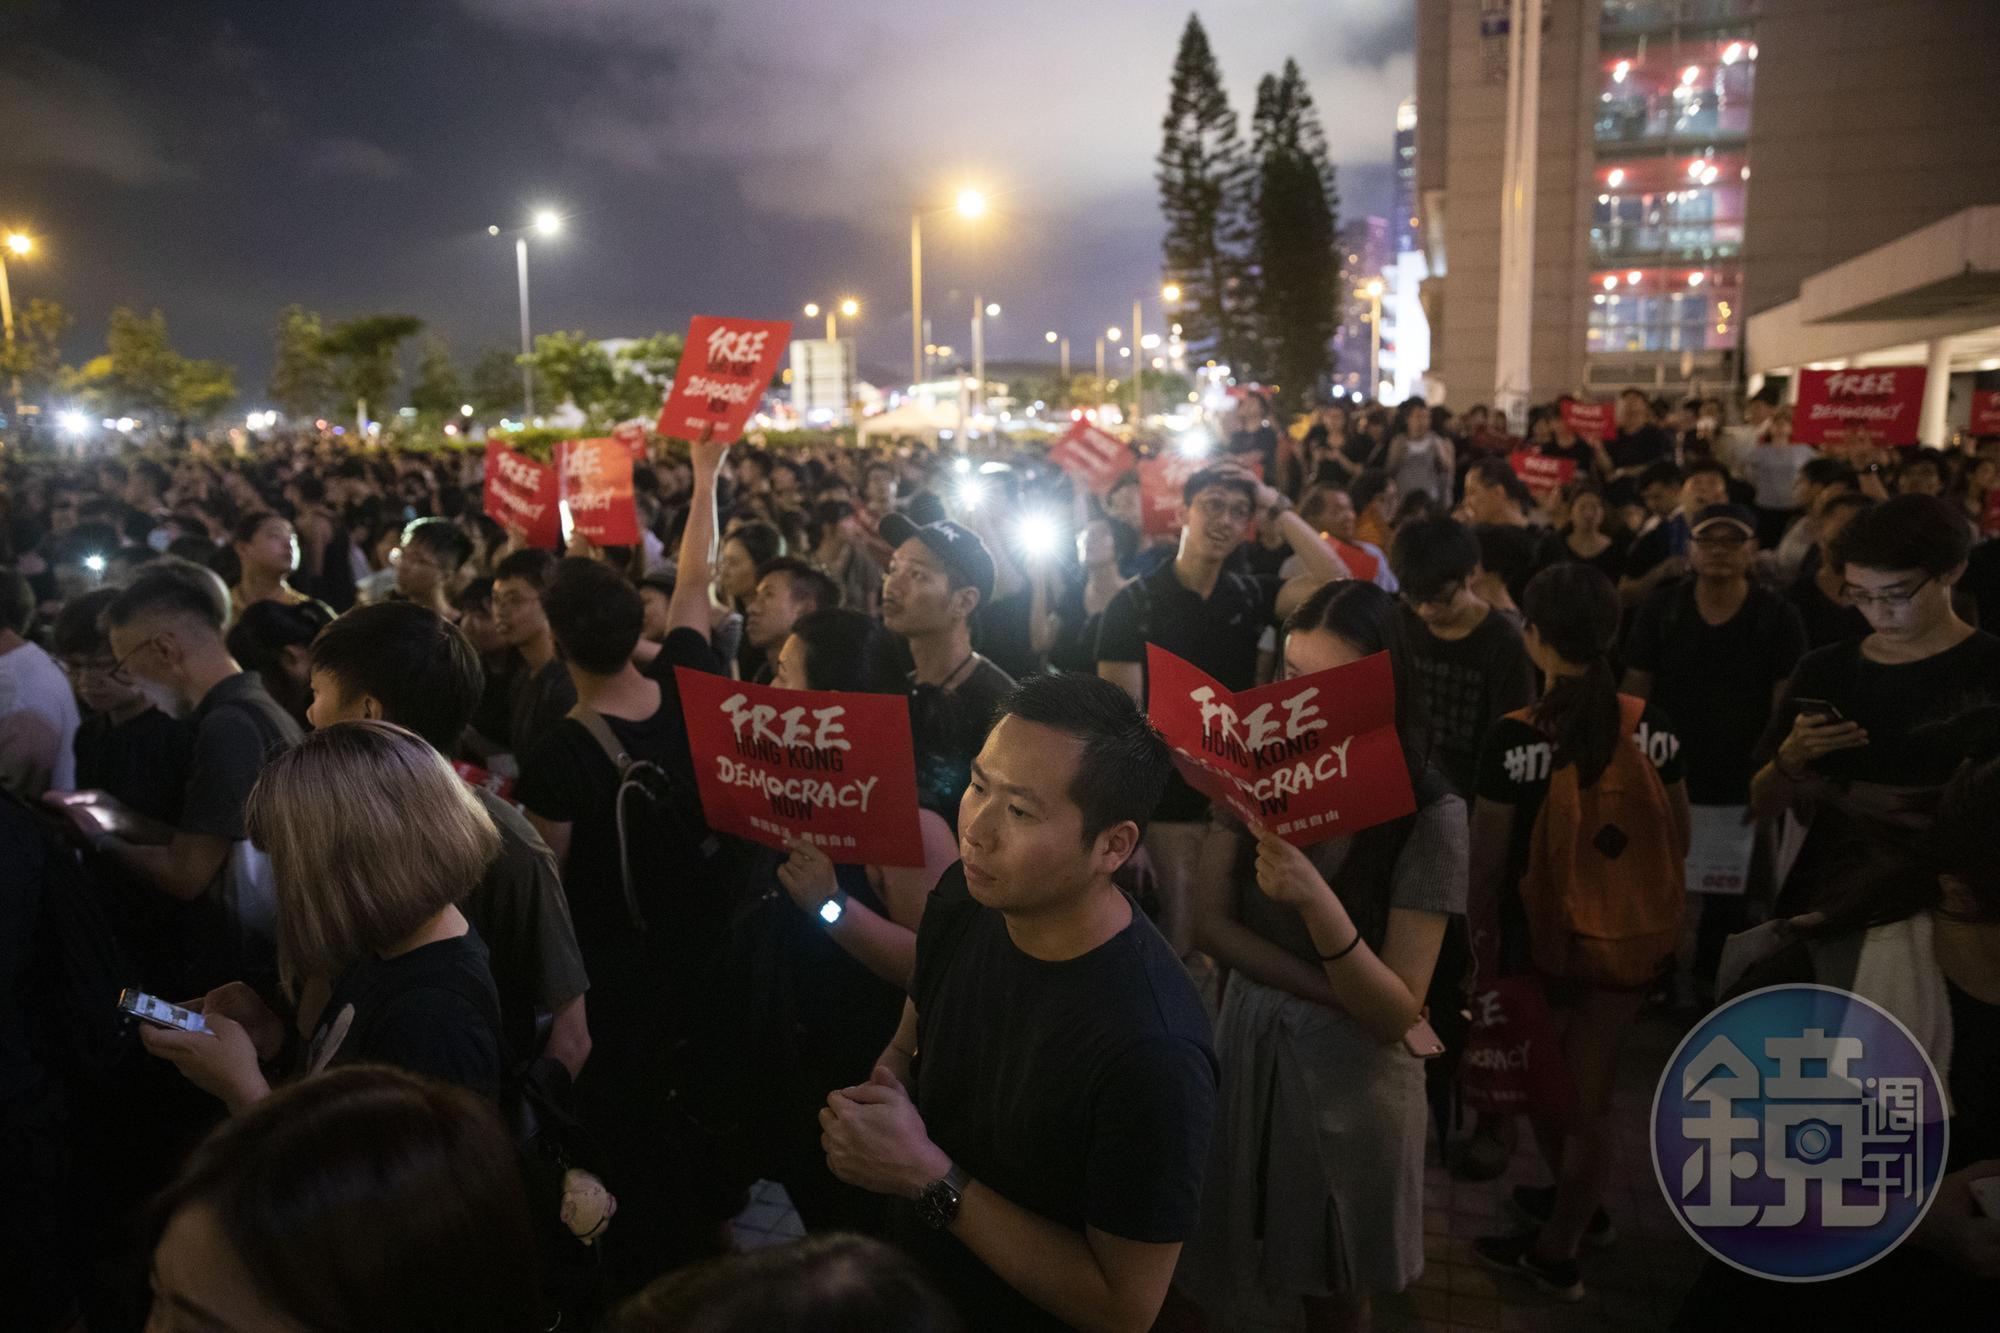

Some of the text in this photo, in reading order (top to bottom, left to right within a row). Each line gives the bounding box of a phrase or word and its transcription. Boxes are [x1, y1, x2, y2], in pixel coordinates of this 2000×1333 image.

[708, 326, 769, 364] FREE
[1824, 372, 1896, 396] FREE
[720, 693, 852, 750] FREE
[1190, 686, 1328, 753] FREE
[735, 731, 844, 772] HONG KONG
[1202, 730, 1320, 769] HONG KONG
[716, 755, 878, 812] DEMOCRACY
[770, 796, 813, 821] NOW
